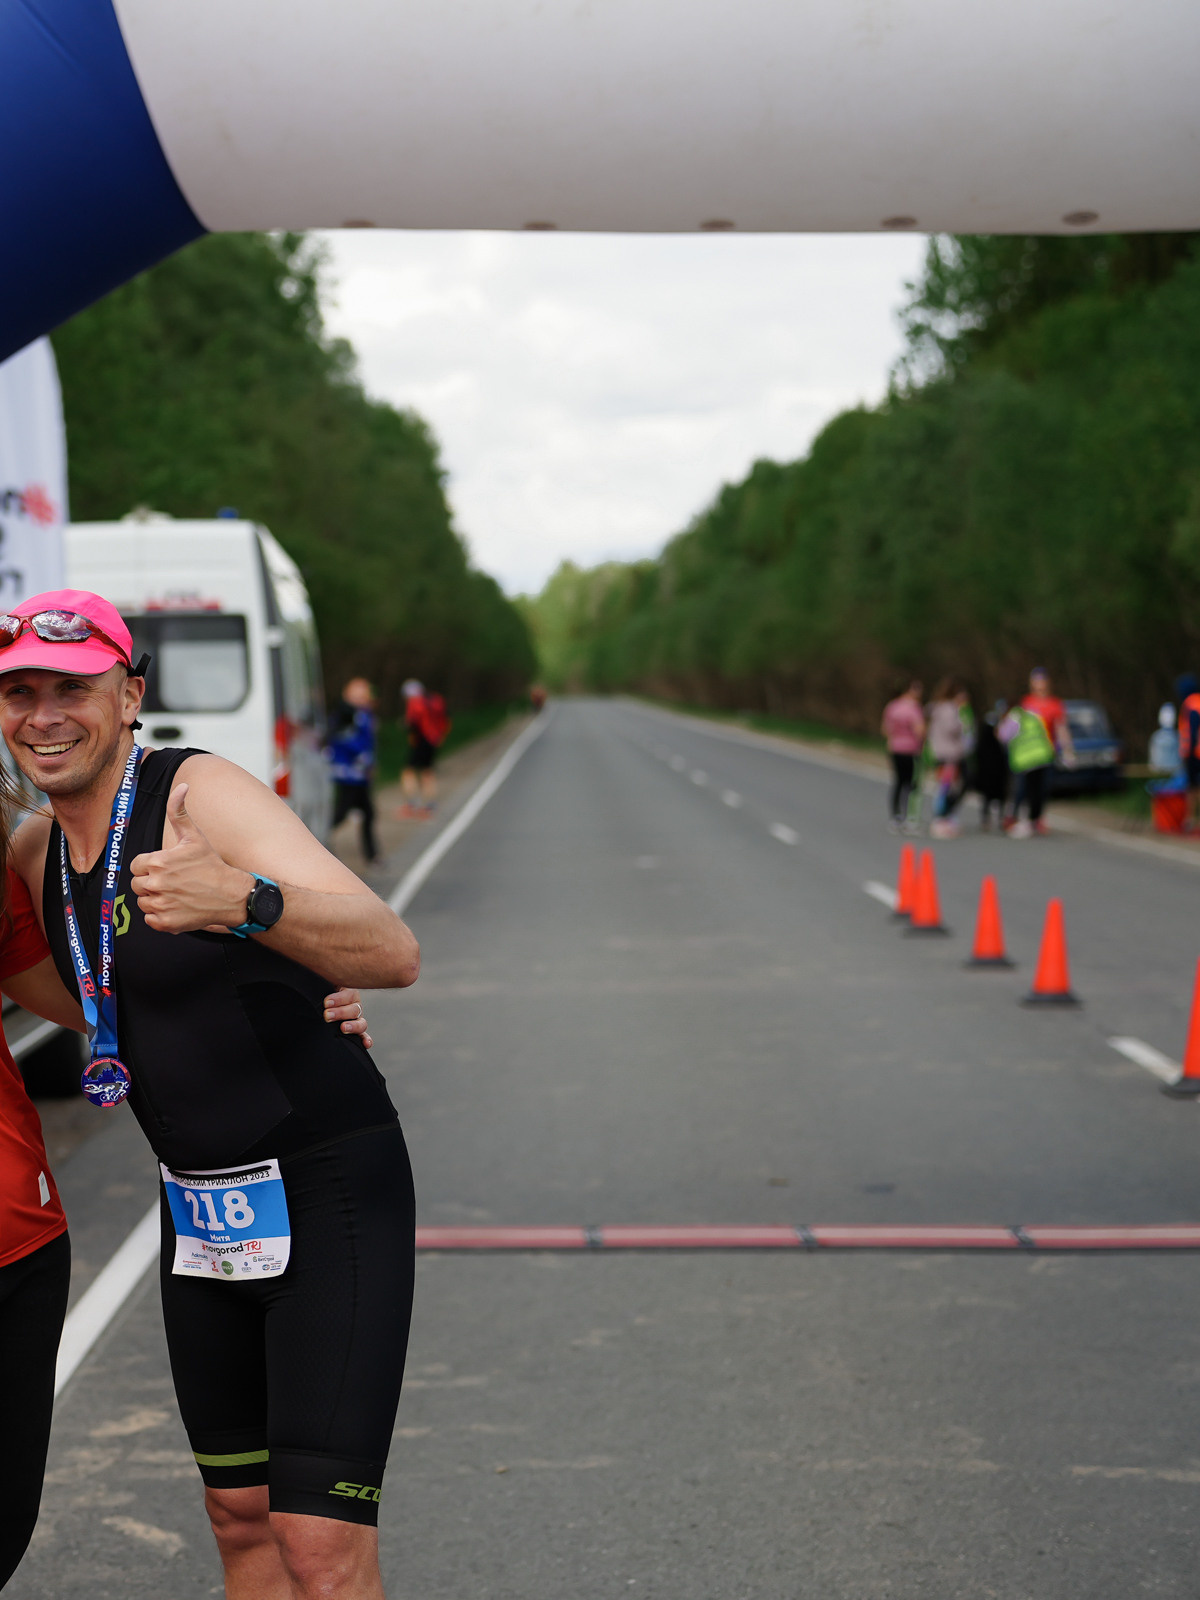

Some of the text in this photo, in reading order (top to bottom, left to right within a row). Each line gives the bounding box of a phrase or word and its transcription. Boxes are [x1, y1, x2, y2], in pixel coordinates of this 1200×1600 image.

[106, 793, 130, 889] НОВГОРОДСКИЙ
[249, 1170, 270, 1182] 2023
[184, 1190, 255, 1231] 218
[209, 1234, 231, 1242] Митя
[328, 1481, 382, 1503] SCO
